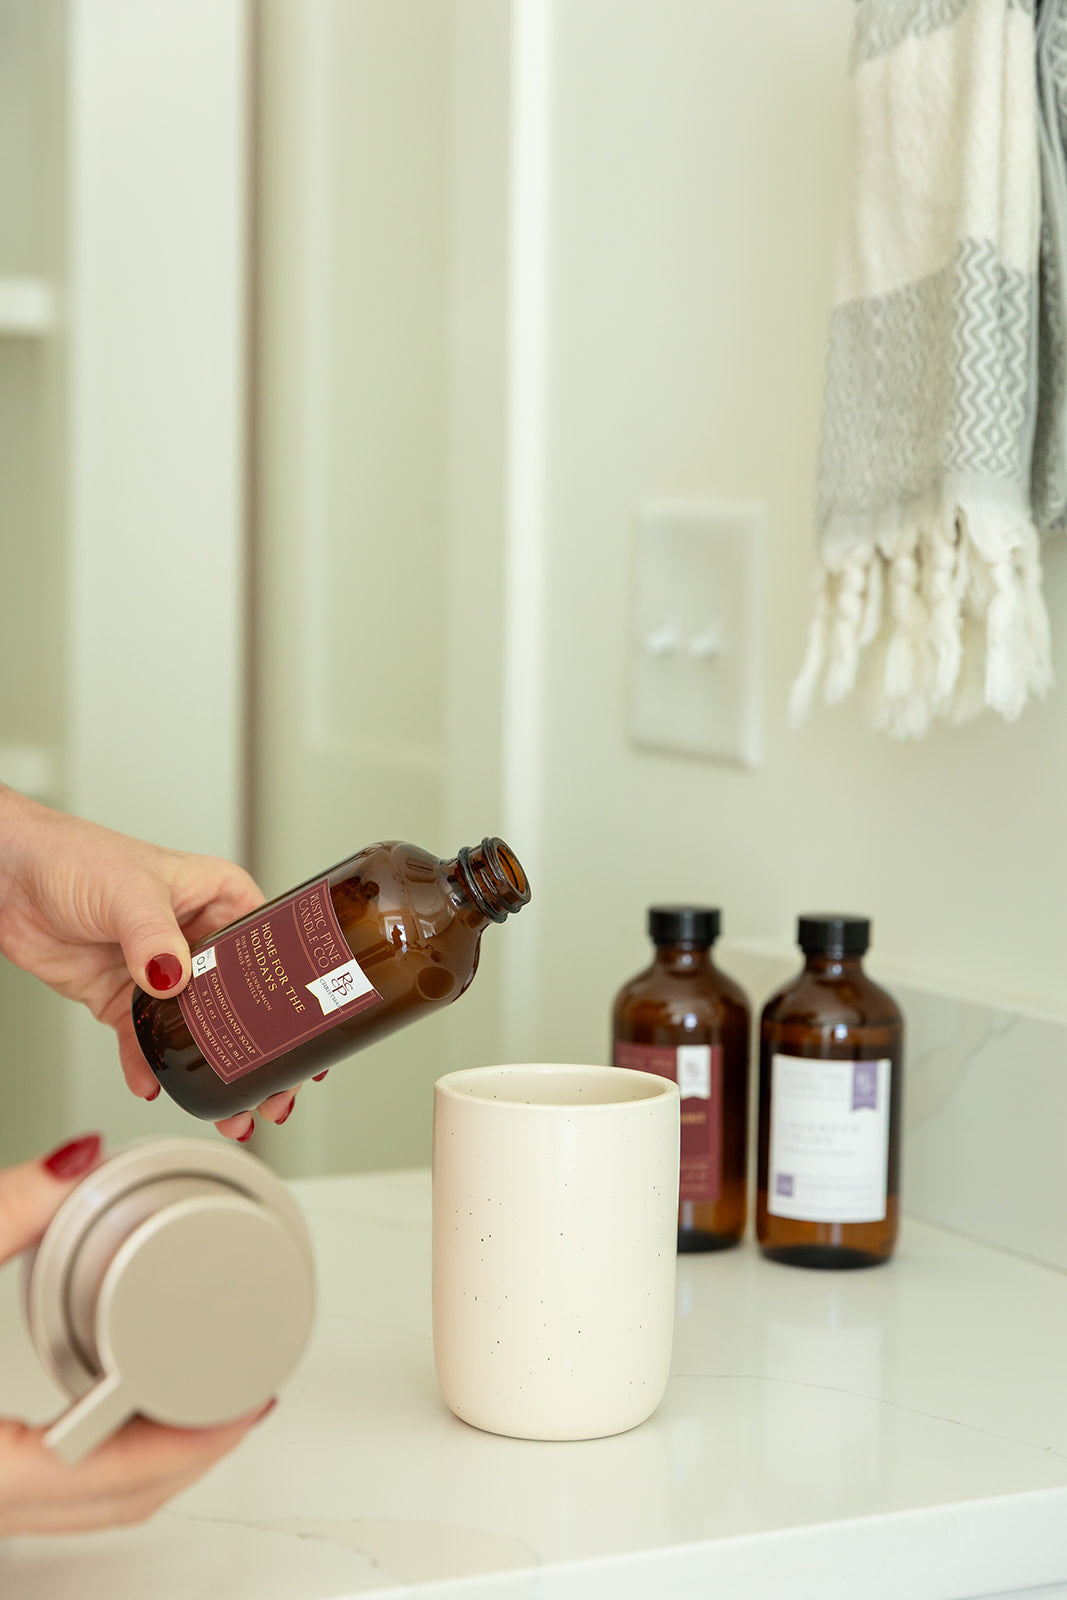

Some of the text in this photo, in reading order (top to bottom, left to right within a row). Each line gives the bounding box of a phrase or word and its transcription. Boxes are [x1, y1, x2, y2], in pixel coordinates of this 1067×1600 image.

[298, 899, 319, 945] CANDLE
[310, 892, 342, 964] RUSTIC PINE
[244, 971, 261, 1005] VANILLA
[249, 970, 273, 1011] CINNAMON
[250, 928, 278, 992] HOLIDAYS
[261, 921, 306, 1014] HOME FOR THE
[188, 991, 198, 1006] THE
[193, 1005, 204, 1021] OLD
[200, 1020, 218, 1047] NORTH
[214, 1046, 233, 1068] STATE
[209, 972, 229, 1010] FOAMING
[225, 1010, 242, 1035] HAND
[239, 1035, 256, 1054] SOAP
